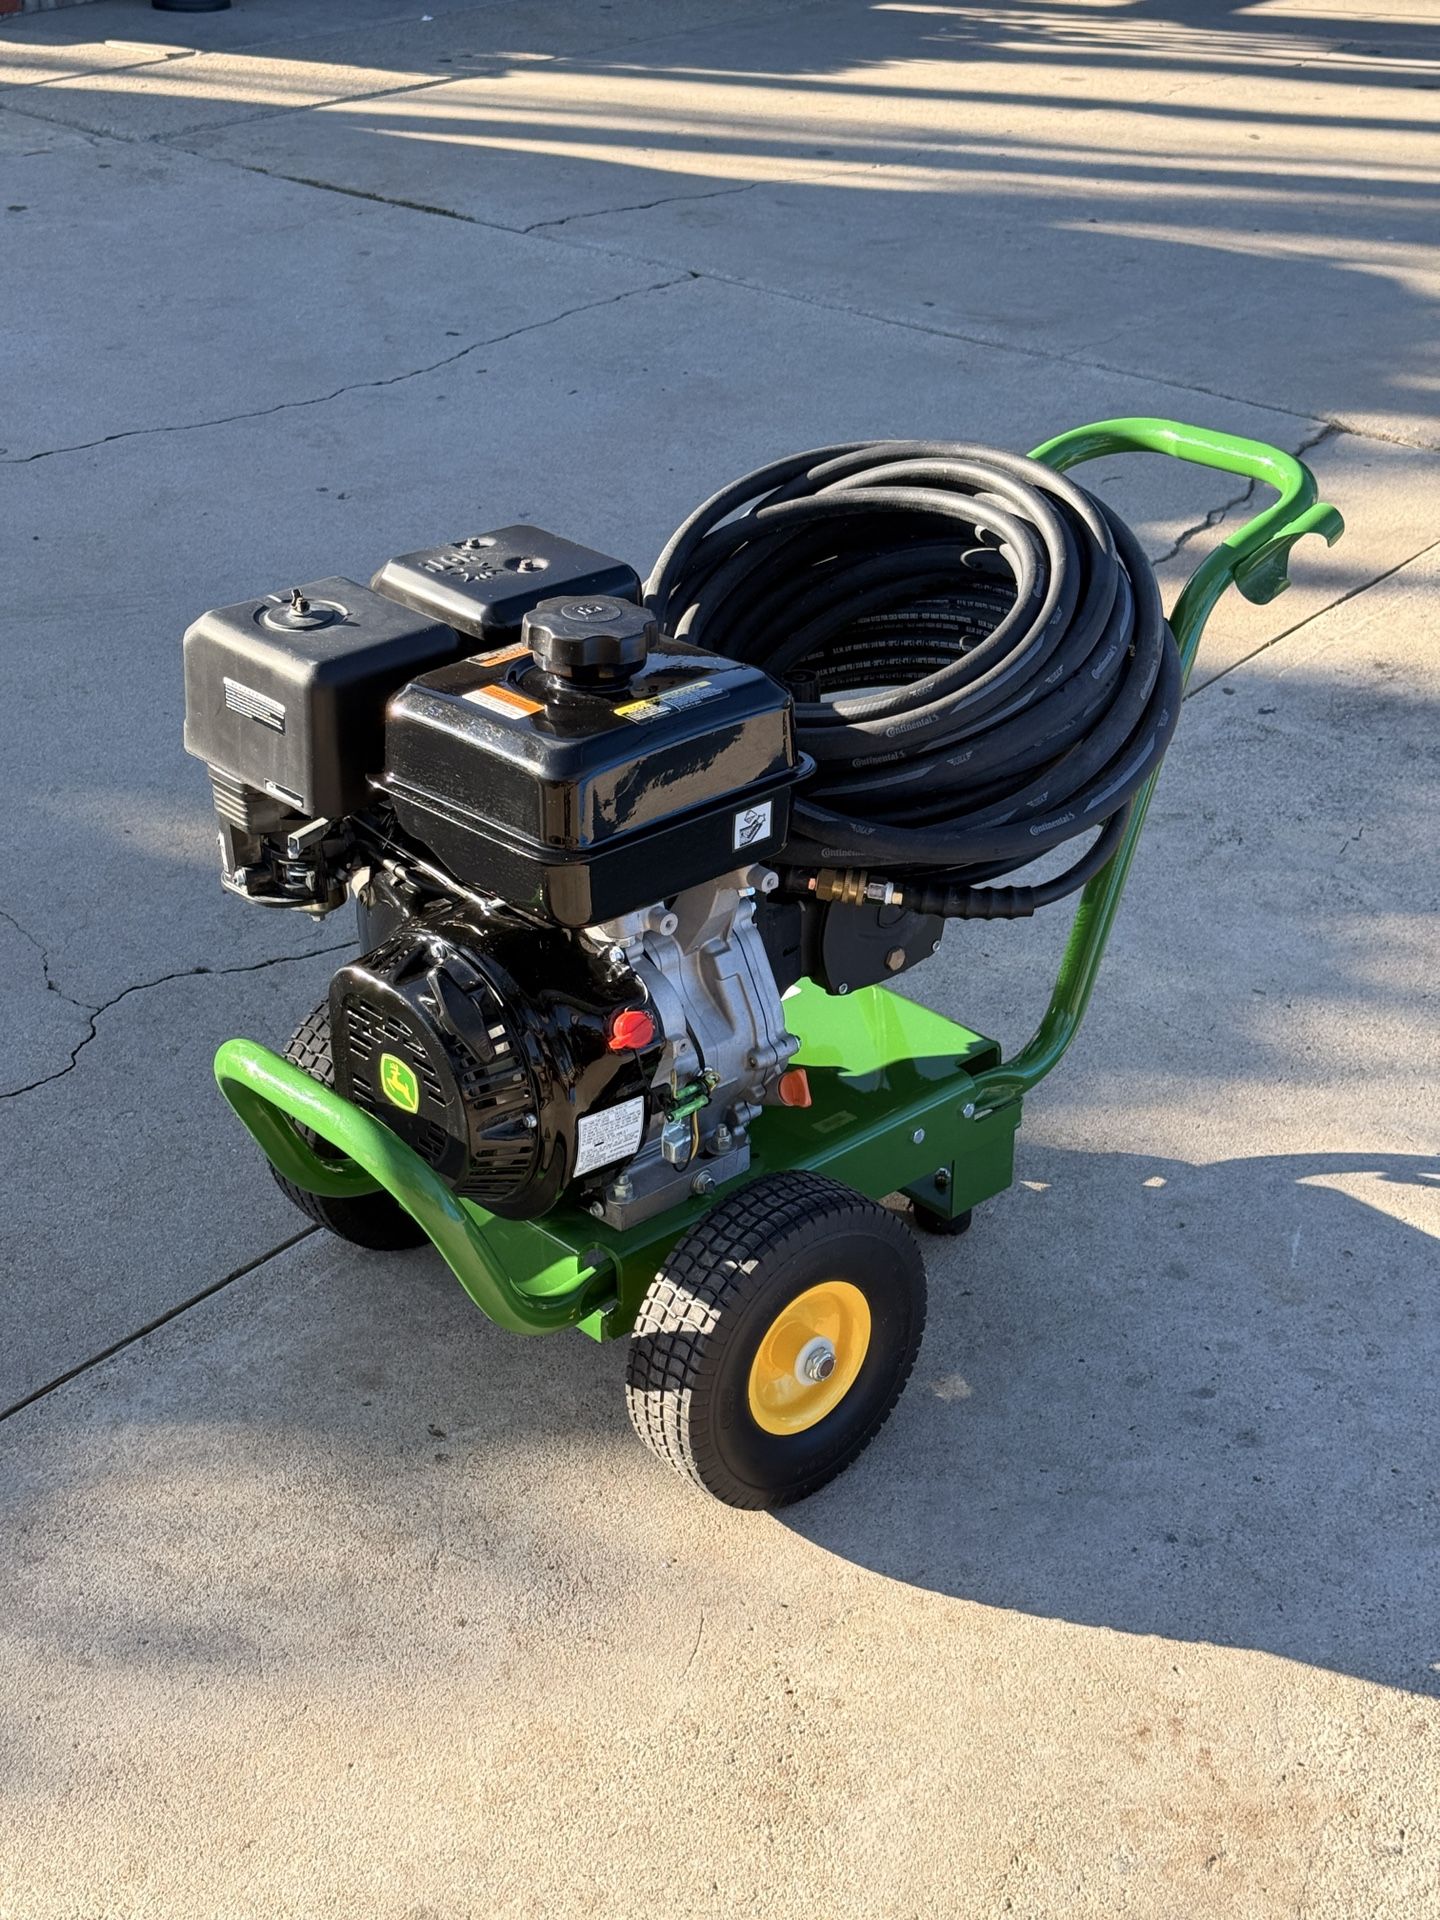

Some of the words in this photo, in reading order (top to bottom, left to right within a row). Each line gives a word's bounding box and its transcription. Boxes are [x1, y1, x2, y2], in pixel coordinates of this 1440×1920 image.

[886, 712, 933, 738] Continental
[851, 751, 900, 769] Continental
[1029, 812, 1071, 836] Continental
